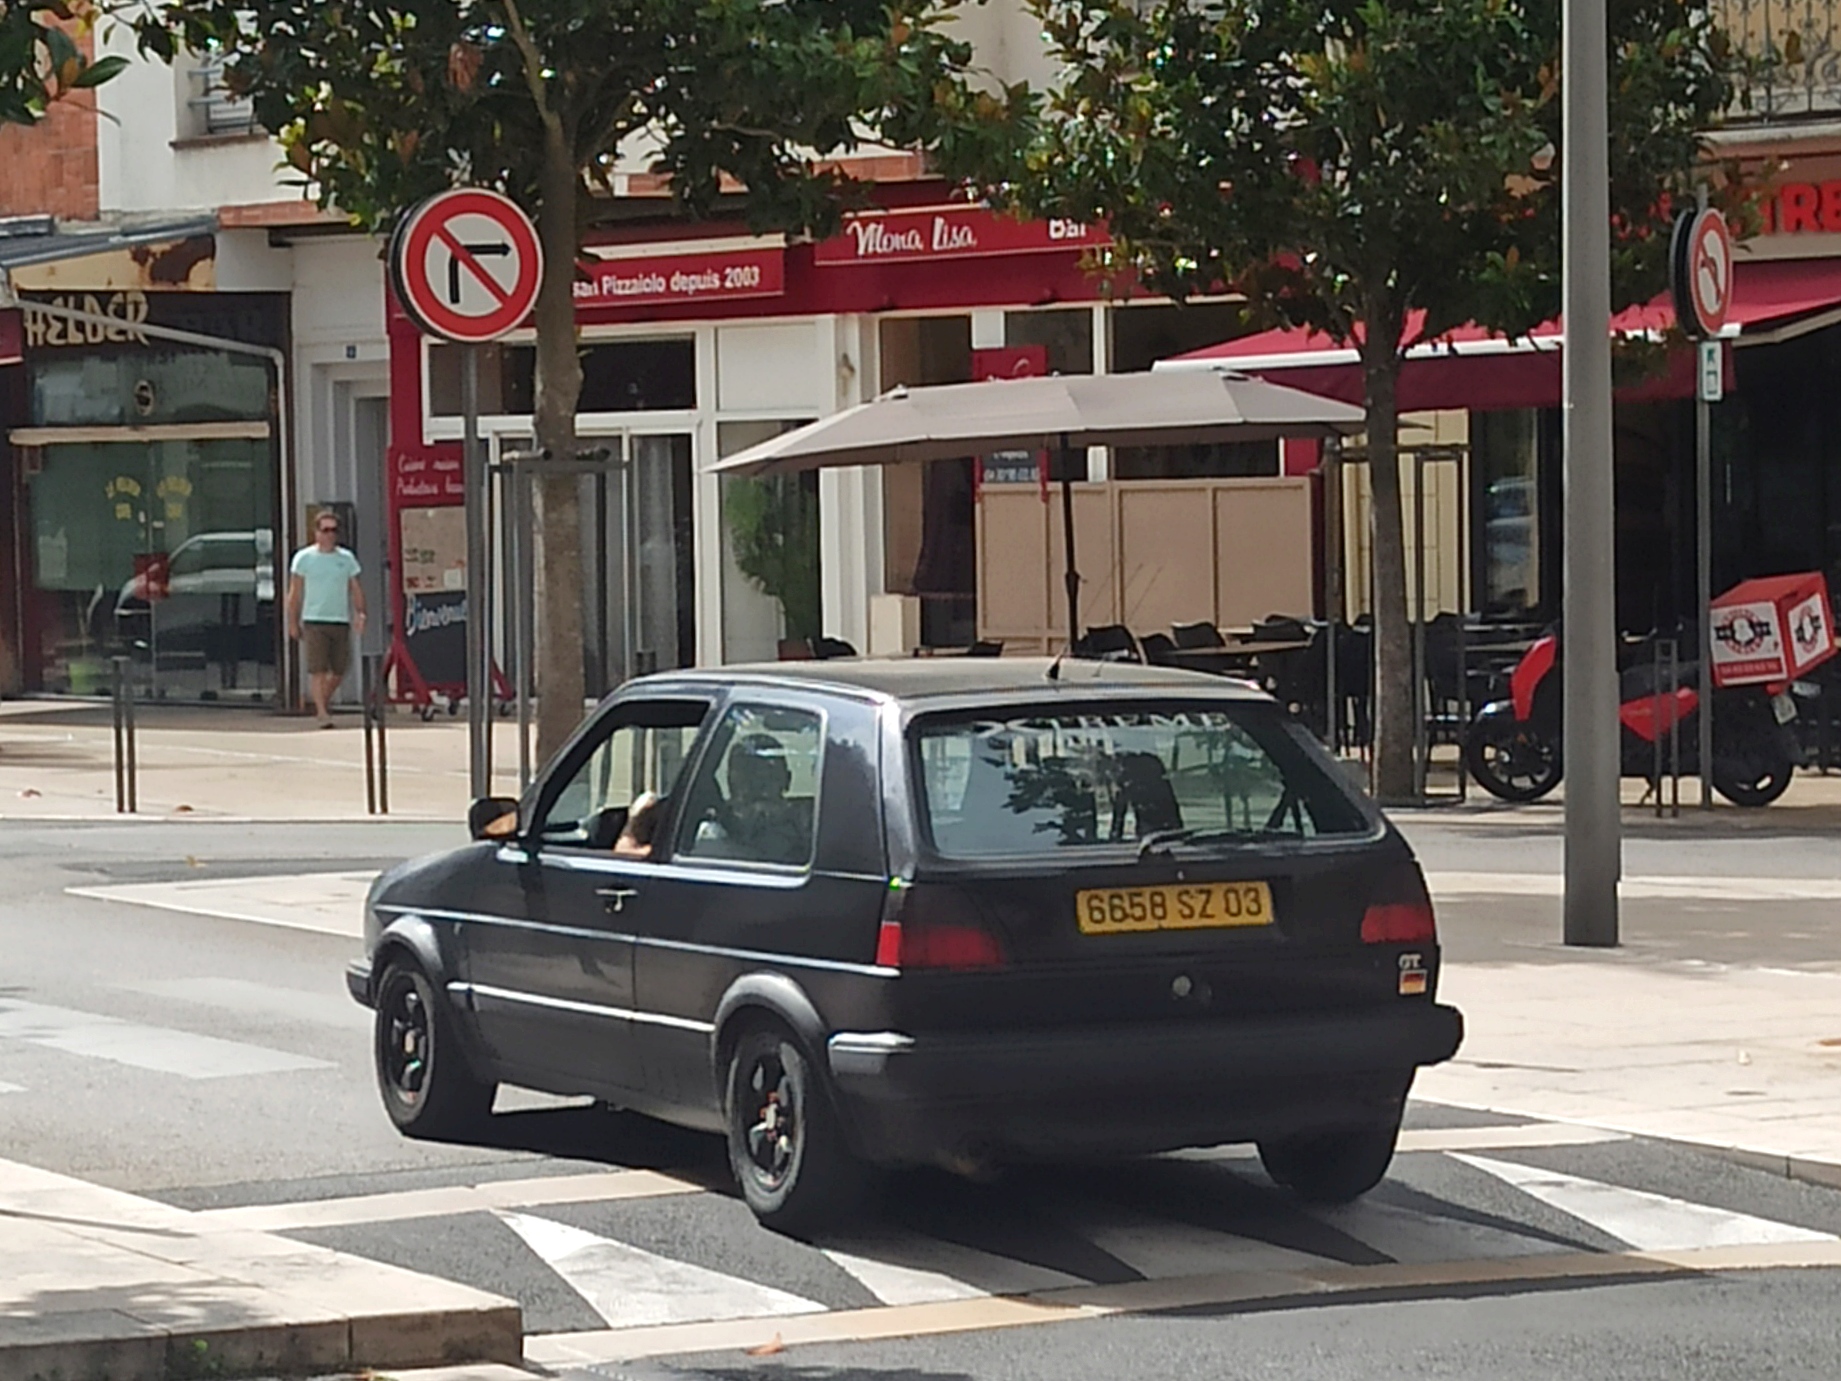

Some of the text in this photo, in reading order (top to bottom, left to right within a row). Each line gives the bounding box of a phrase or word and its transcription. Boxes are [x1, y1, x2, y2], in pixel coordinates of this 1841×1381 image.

[846, 215, 977, 256] Mona Lisa
[601, 271, 666, 296] Pizzaiolo
[670, 268, 720, 296] depuis
[724, 265, 760, 289] 2003
[23, 290, 151, 348] HELDER
[1086, 886, 1262, 925] 6658 SZ 03
